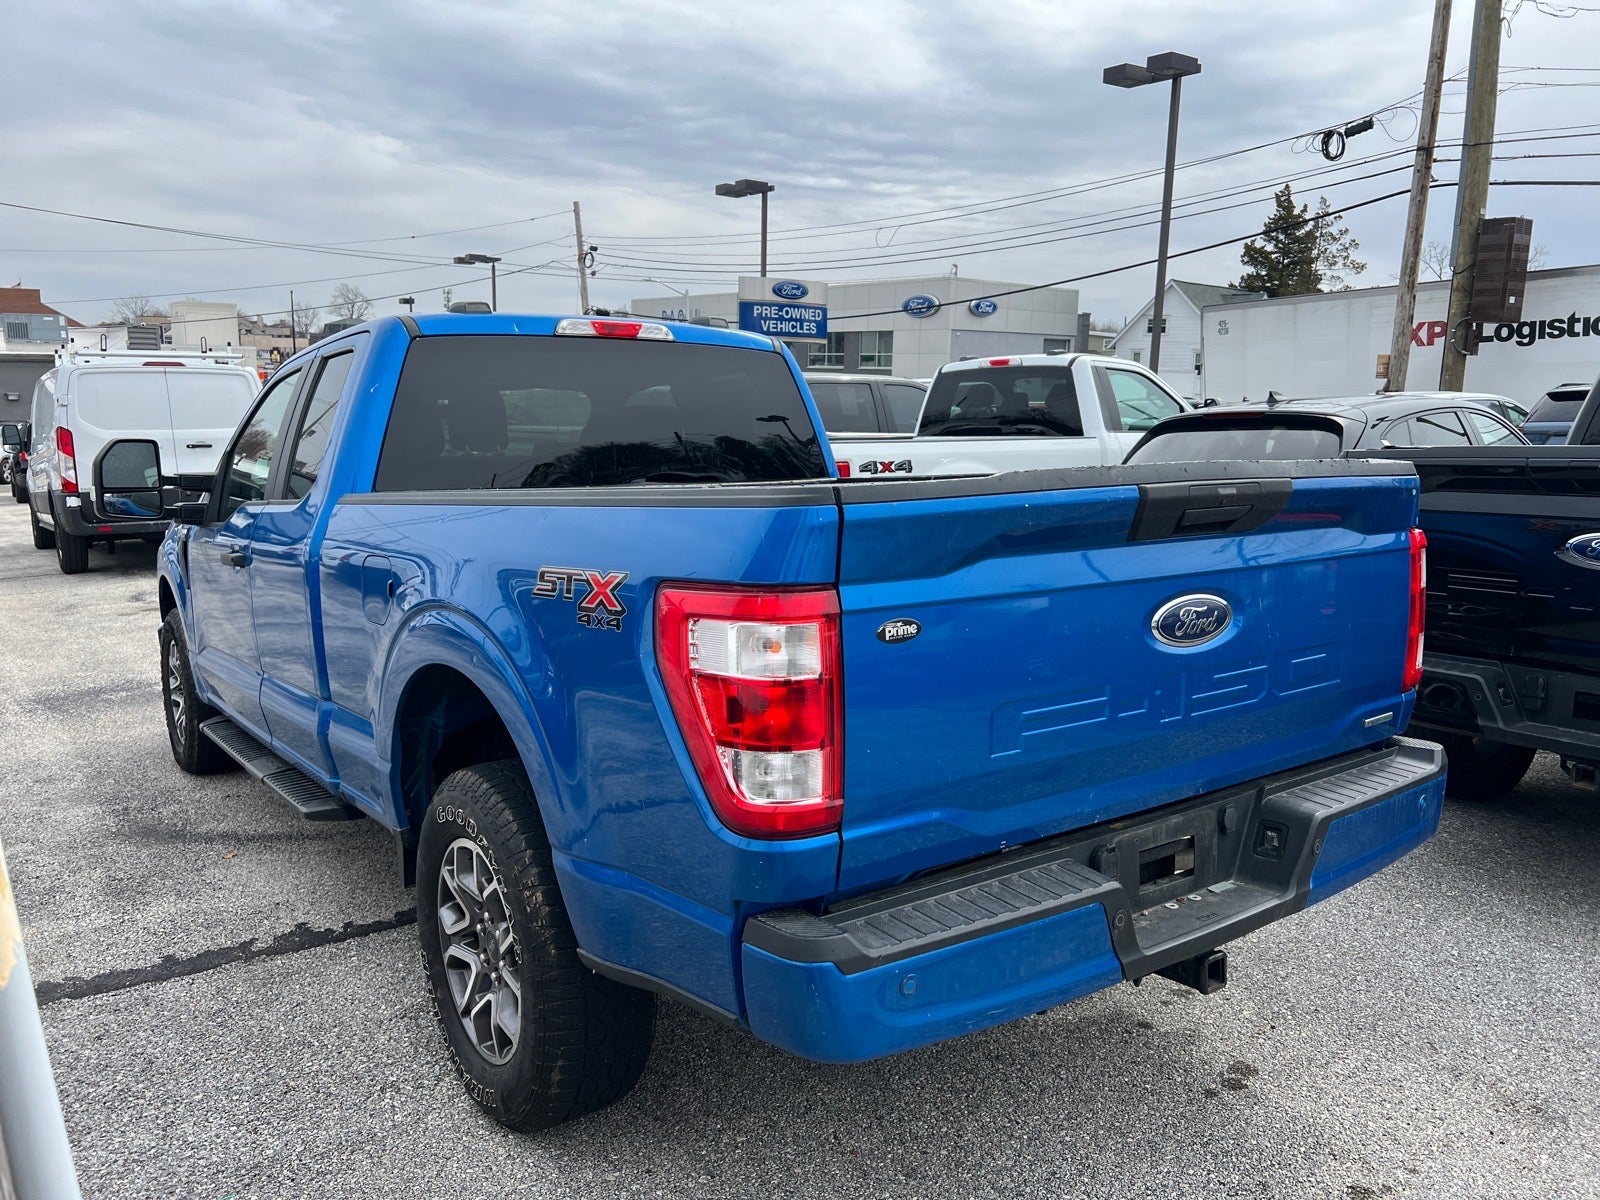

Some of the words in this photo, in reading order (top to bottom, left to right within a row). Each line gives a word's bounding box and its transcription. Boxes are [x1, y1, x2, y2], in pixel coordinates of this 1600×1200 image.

[753, 305, 822, 321] PRE-OWNED
[761, 320, 817, 334] VEHICLES
[531, 566, 629, 617] STX
[1174, 605, 1218, 637] Ford
[988, 641, 1344, 759] F-150
